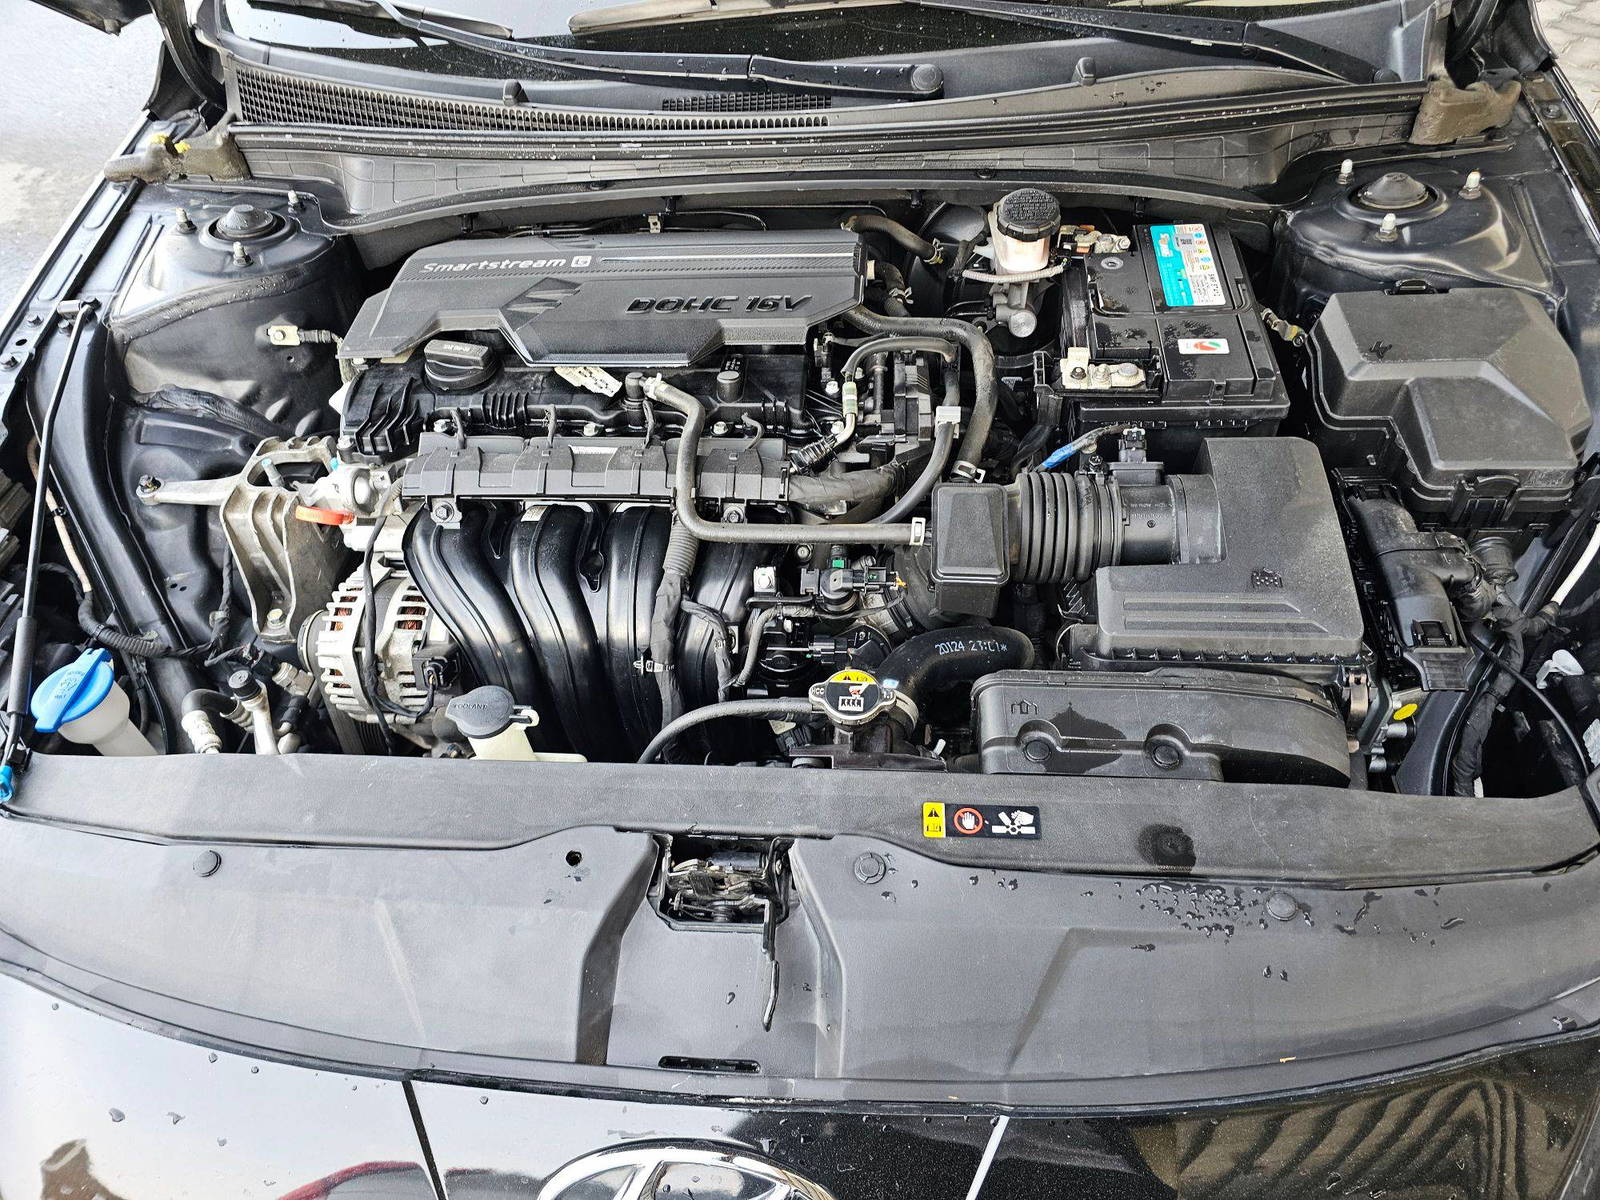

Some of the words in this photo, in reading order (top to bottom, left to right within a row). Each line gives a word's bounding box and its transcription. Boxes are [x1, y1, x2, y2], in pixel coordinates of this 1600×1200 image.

[419, 257, 567, 273] Smartstream
[625, 295, 739, 313] DOHC
[745, 294, 813, 312] 16V
